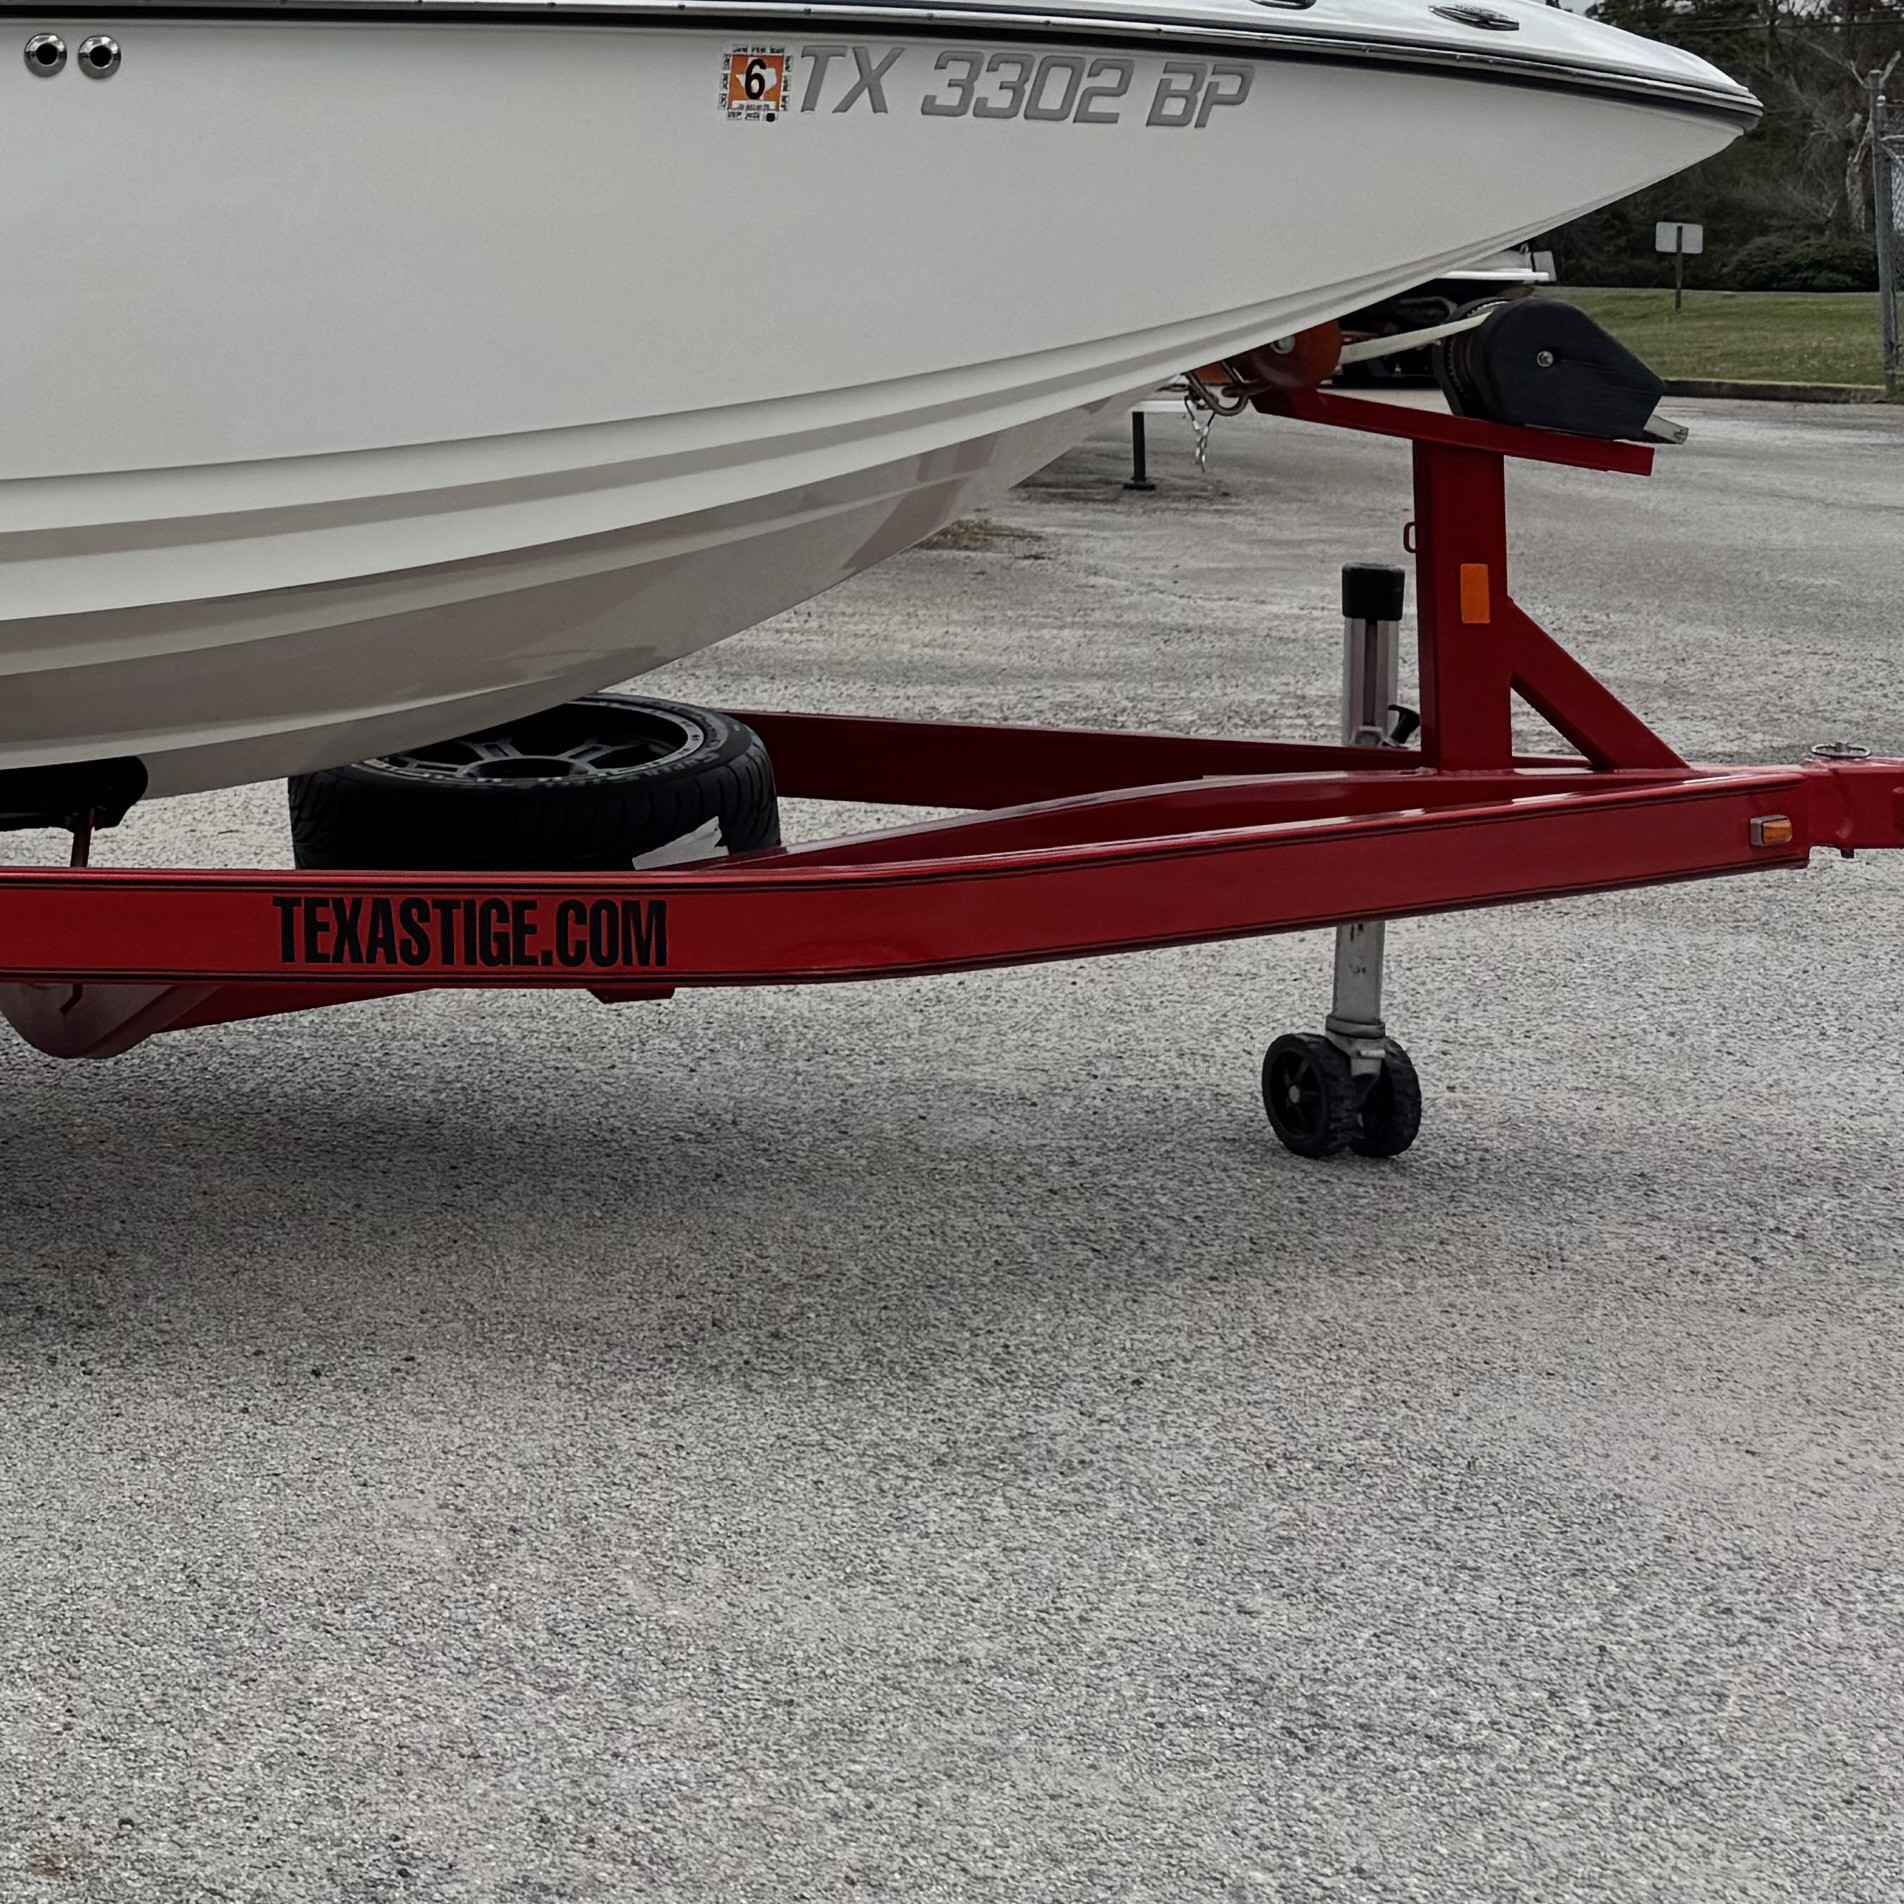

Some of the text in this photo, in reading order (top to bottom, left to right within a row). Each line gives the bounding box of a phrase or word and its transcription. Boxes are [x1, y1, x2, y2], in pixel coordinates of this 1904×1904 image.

[745, 58, 768, 100] 6
[799, 44, 907, 115] TX
[921, 49, 1137, 125] 3302
[1145, 60, 1256, 129] BP
[273, 896, 669, 968] TEXASTIGE.COM
